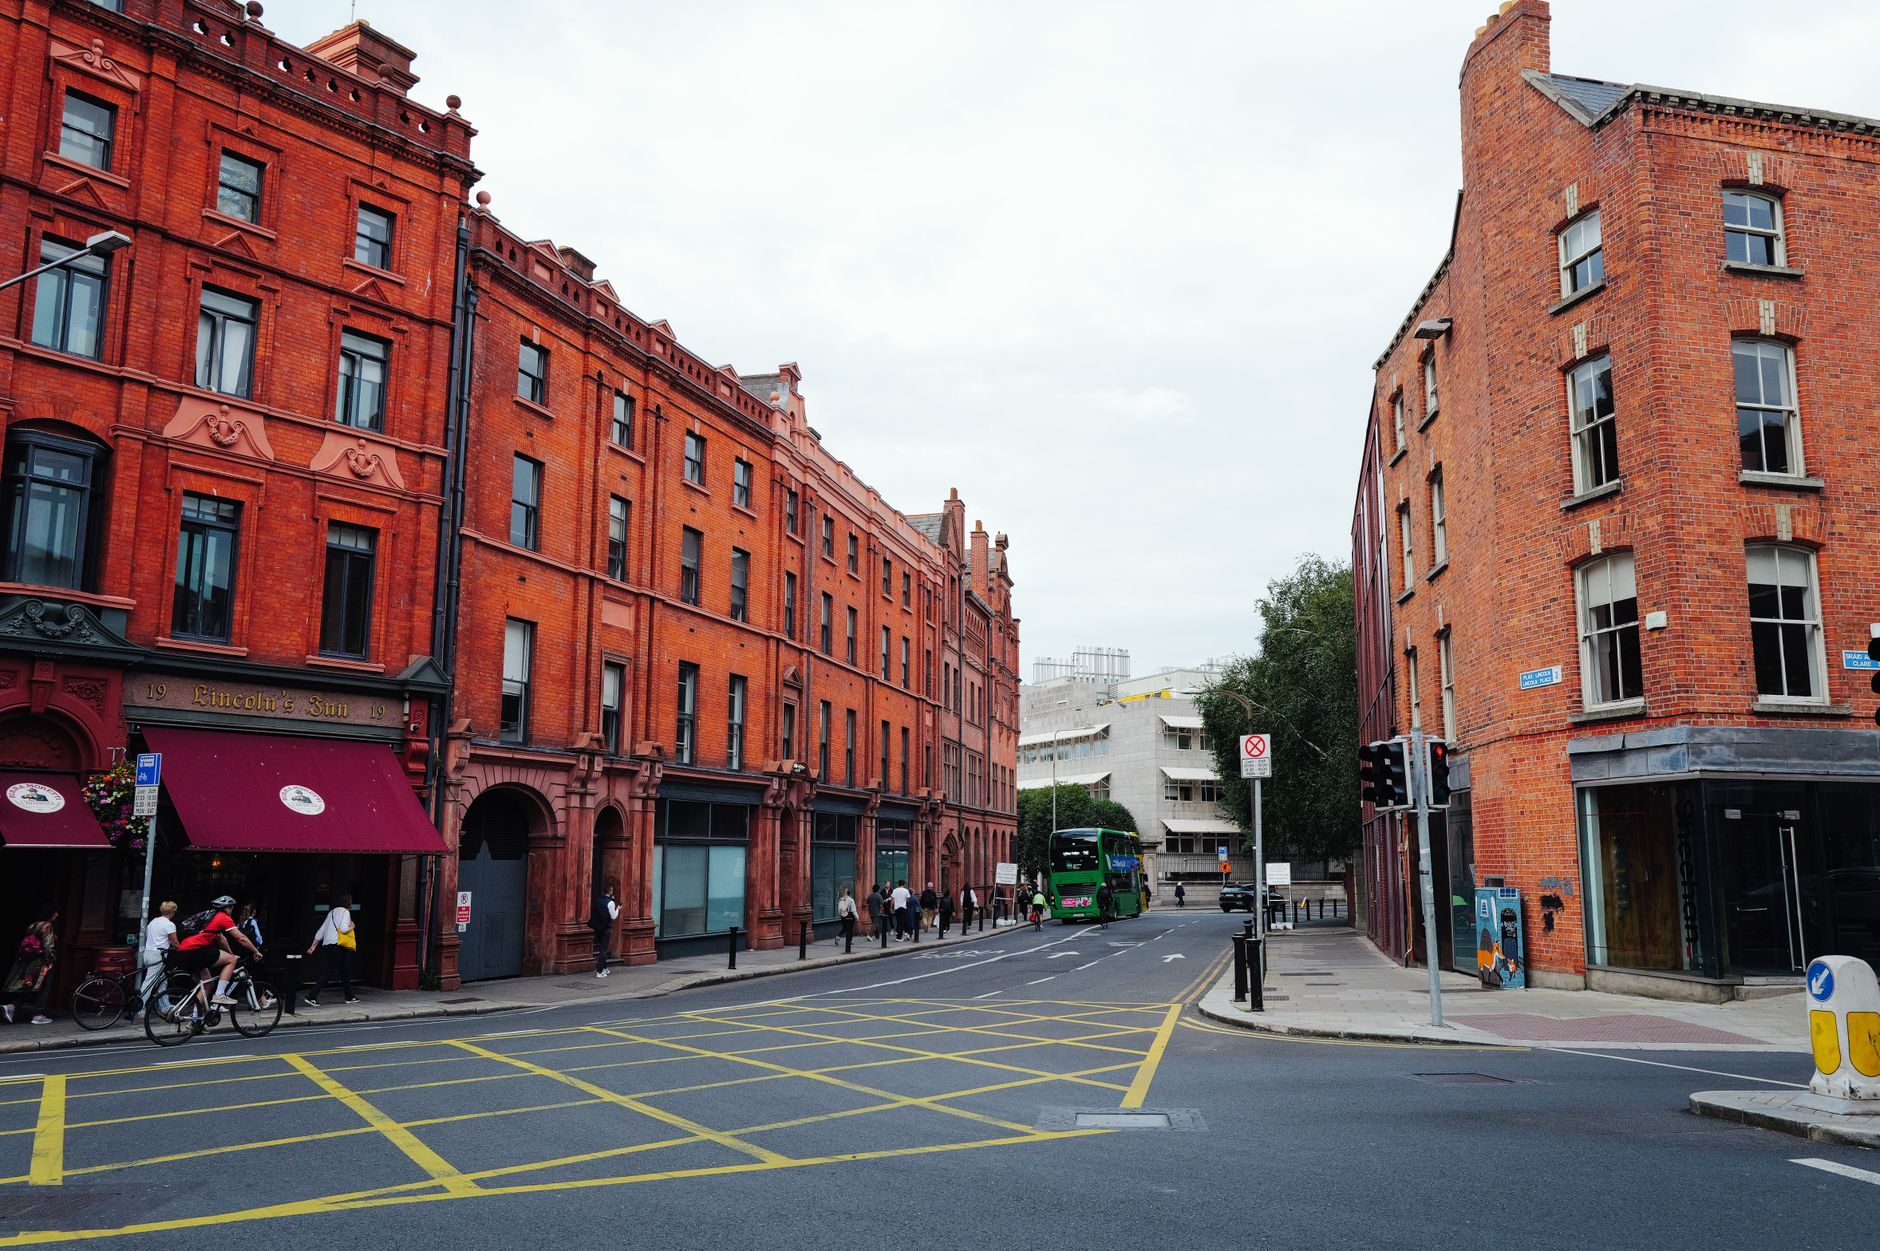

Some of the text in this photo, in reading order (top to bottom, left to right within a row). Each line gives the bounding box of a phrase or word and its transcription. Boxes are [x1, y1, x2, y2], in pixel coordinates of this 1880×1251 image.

[147, 683, 386, 720] 19 Lincoln's Inn 19
